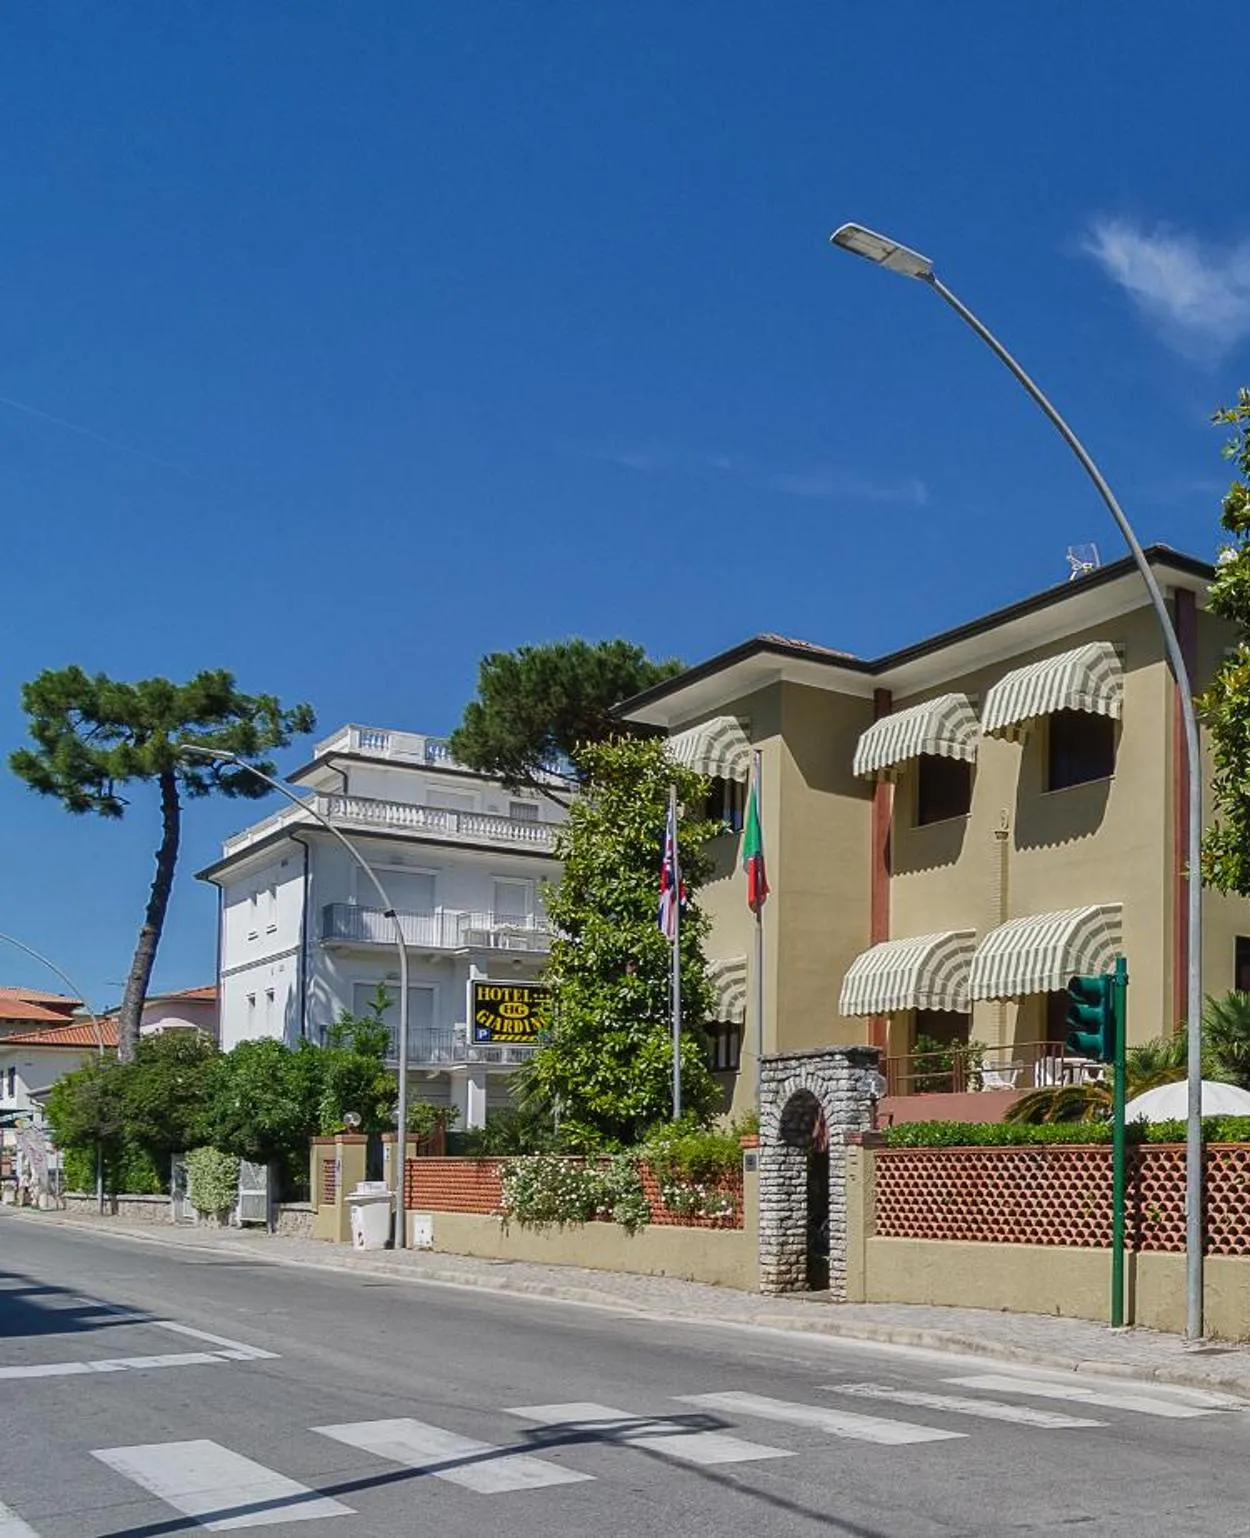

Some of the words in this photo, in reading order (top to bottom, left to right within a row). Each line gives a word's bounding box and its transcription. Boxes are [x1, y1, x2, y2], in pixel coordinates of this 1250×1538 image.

[477, 986, 533, 1002] HOTEL
[503, 1004, 526, 1015] HG
[476, 1008, 547, 1034] GIARDIN
